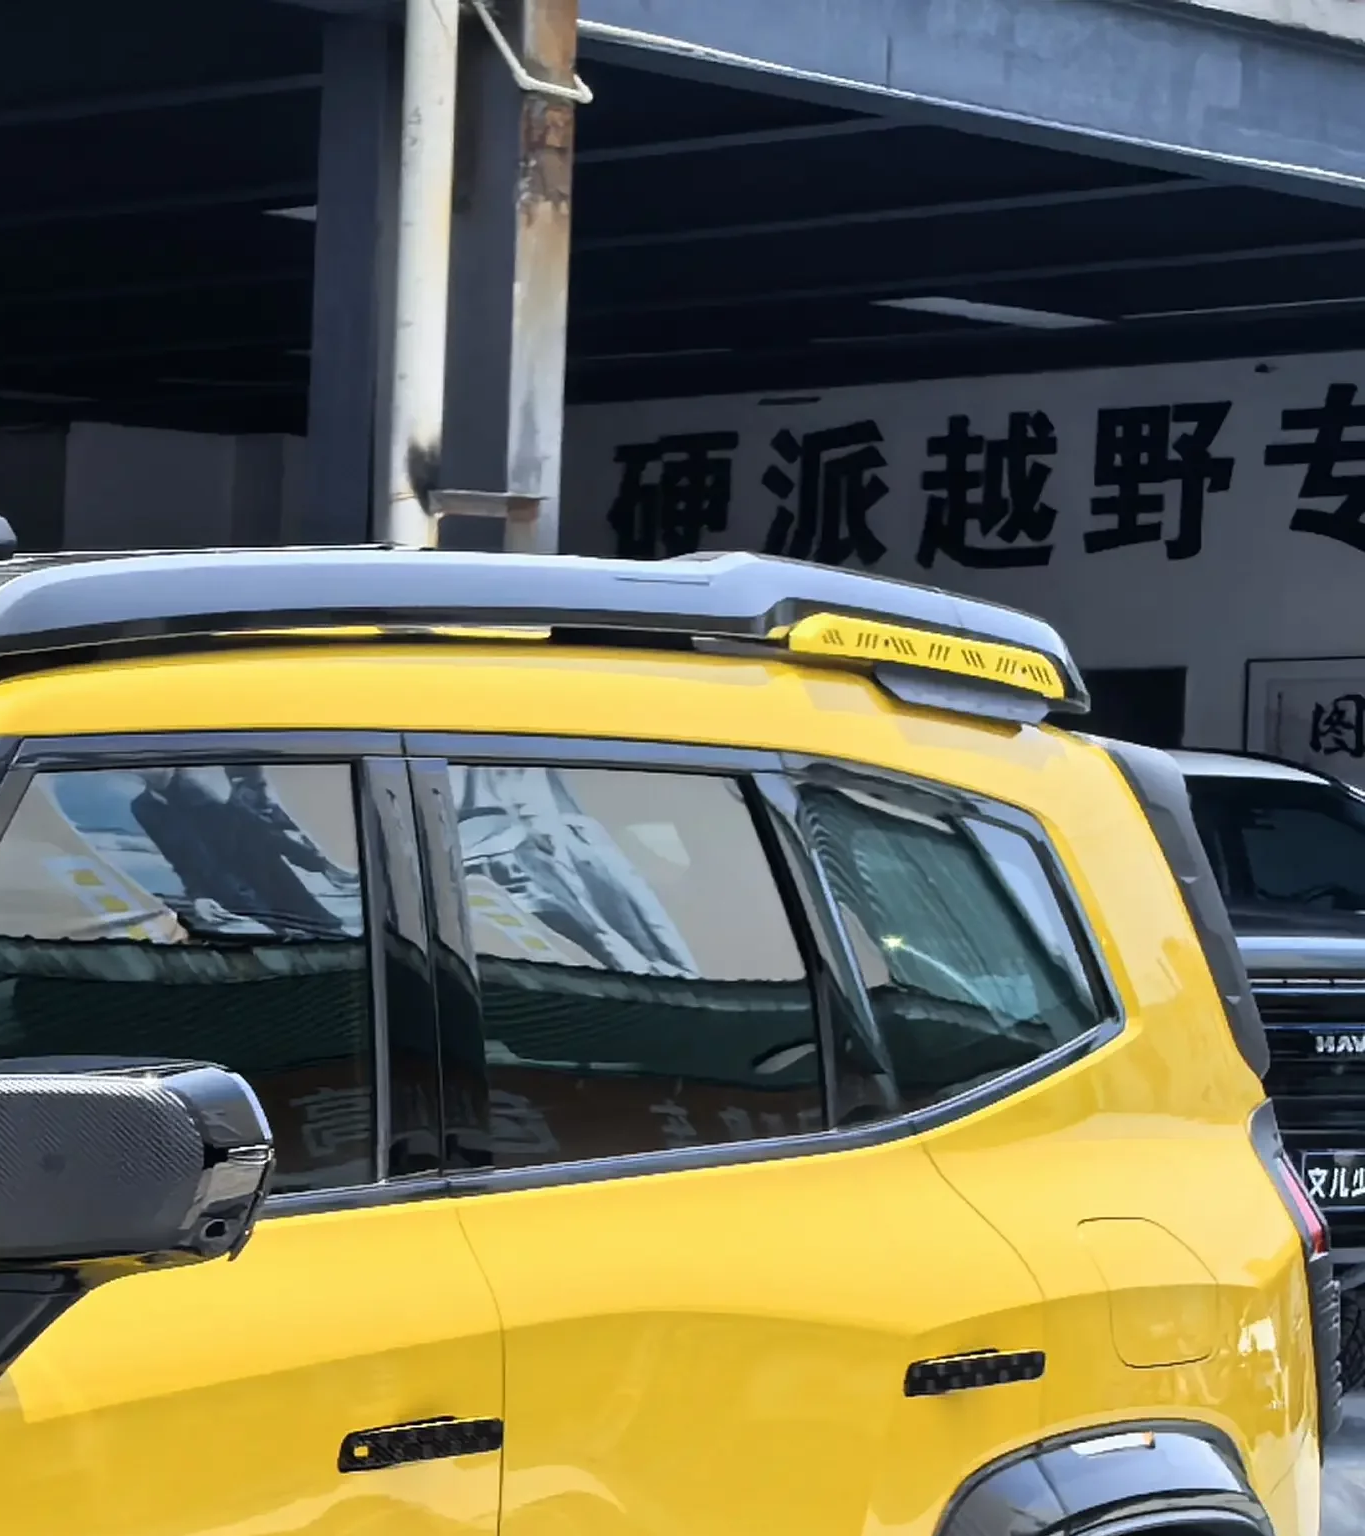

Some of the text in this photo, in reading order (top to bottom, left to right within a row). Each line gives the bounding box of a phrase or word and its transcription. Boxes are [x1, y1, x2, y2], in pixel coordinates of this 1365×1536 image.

[607, 383, 1365, 569] 硬派越野专
